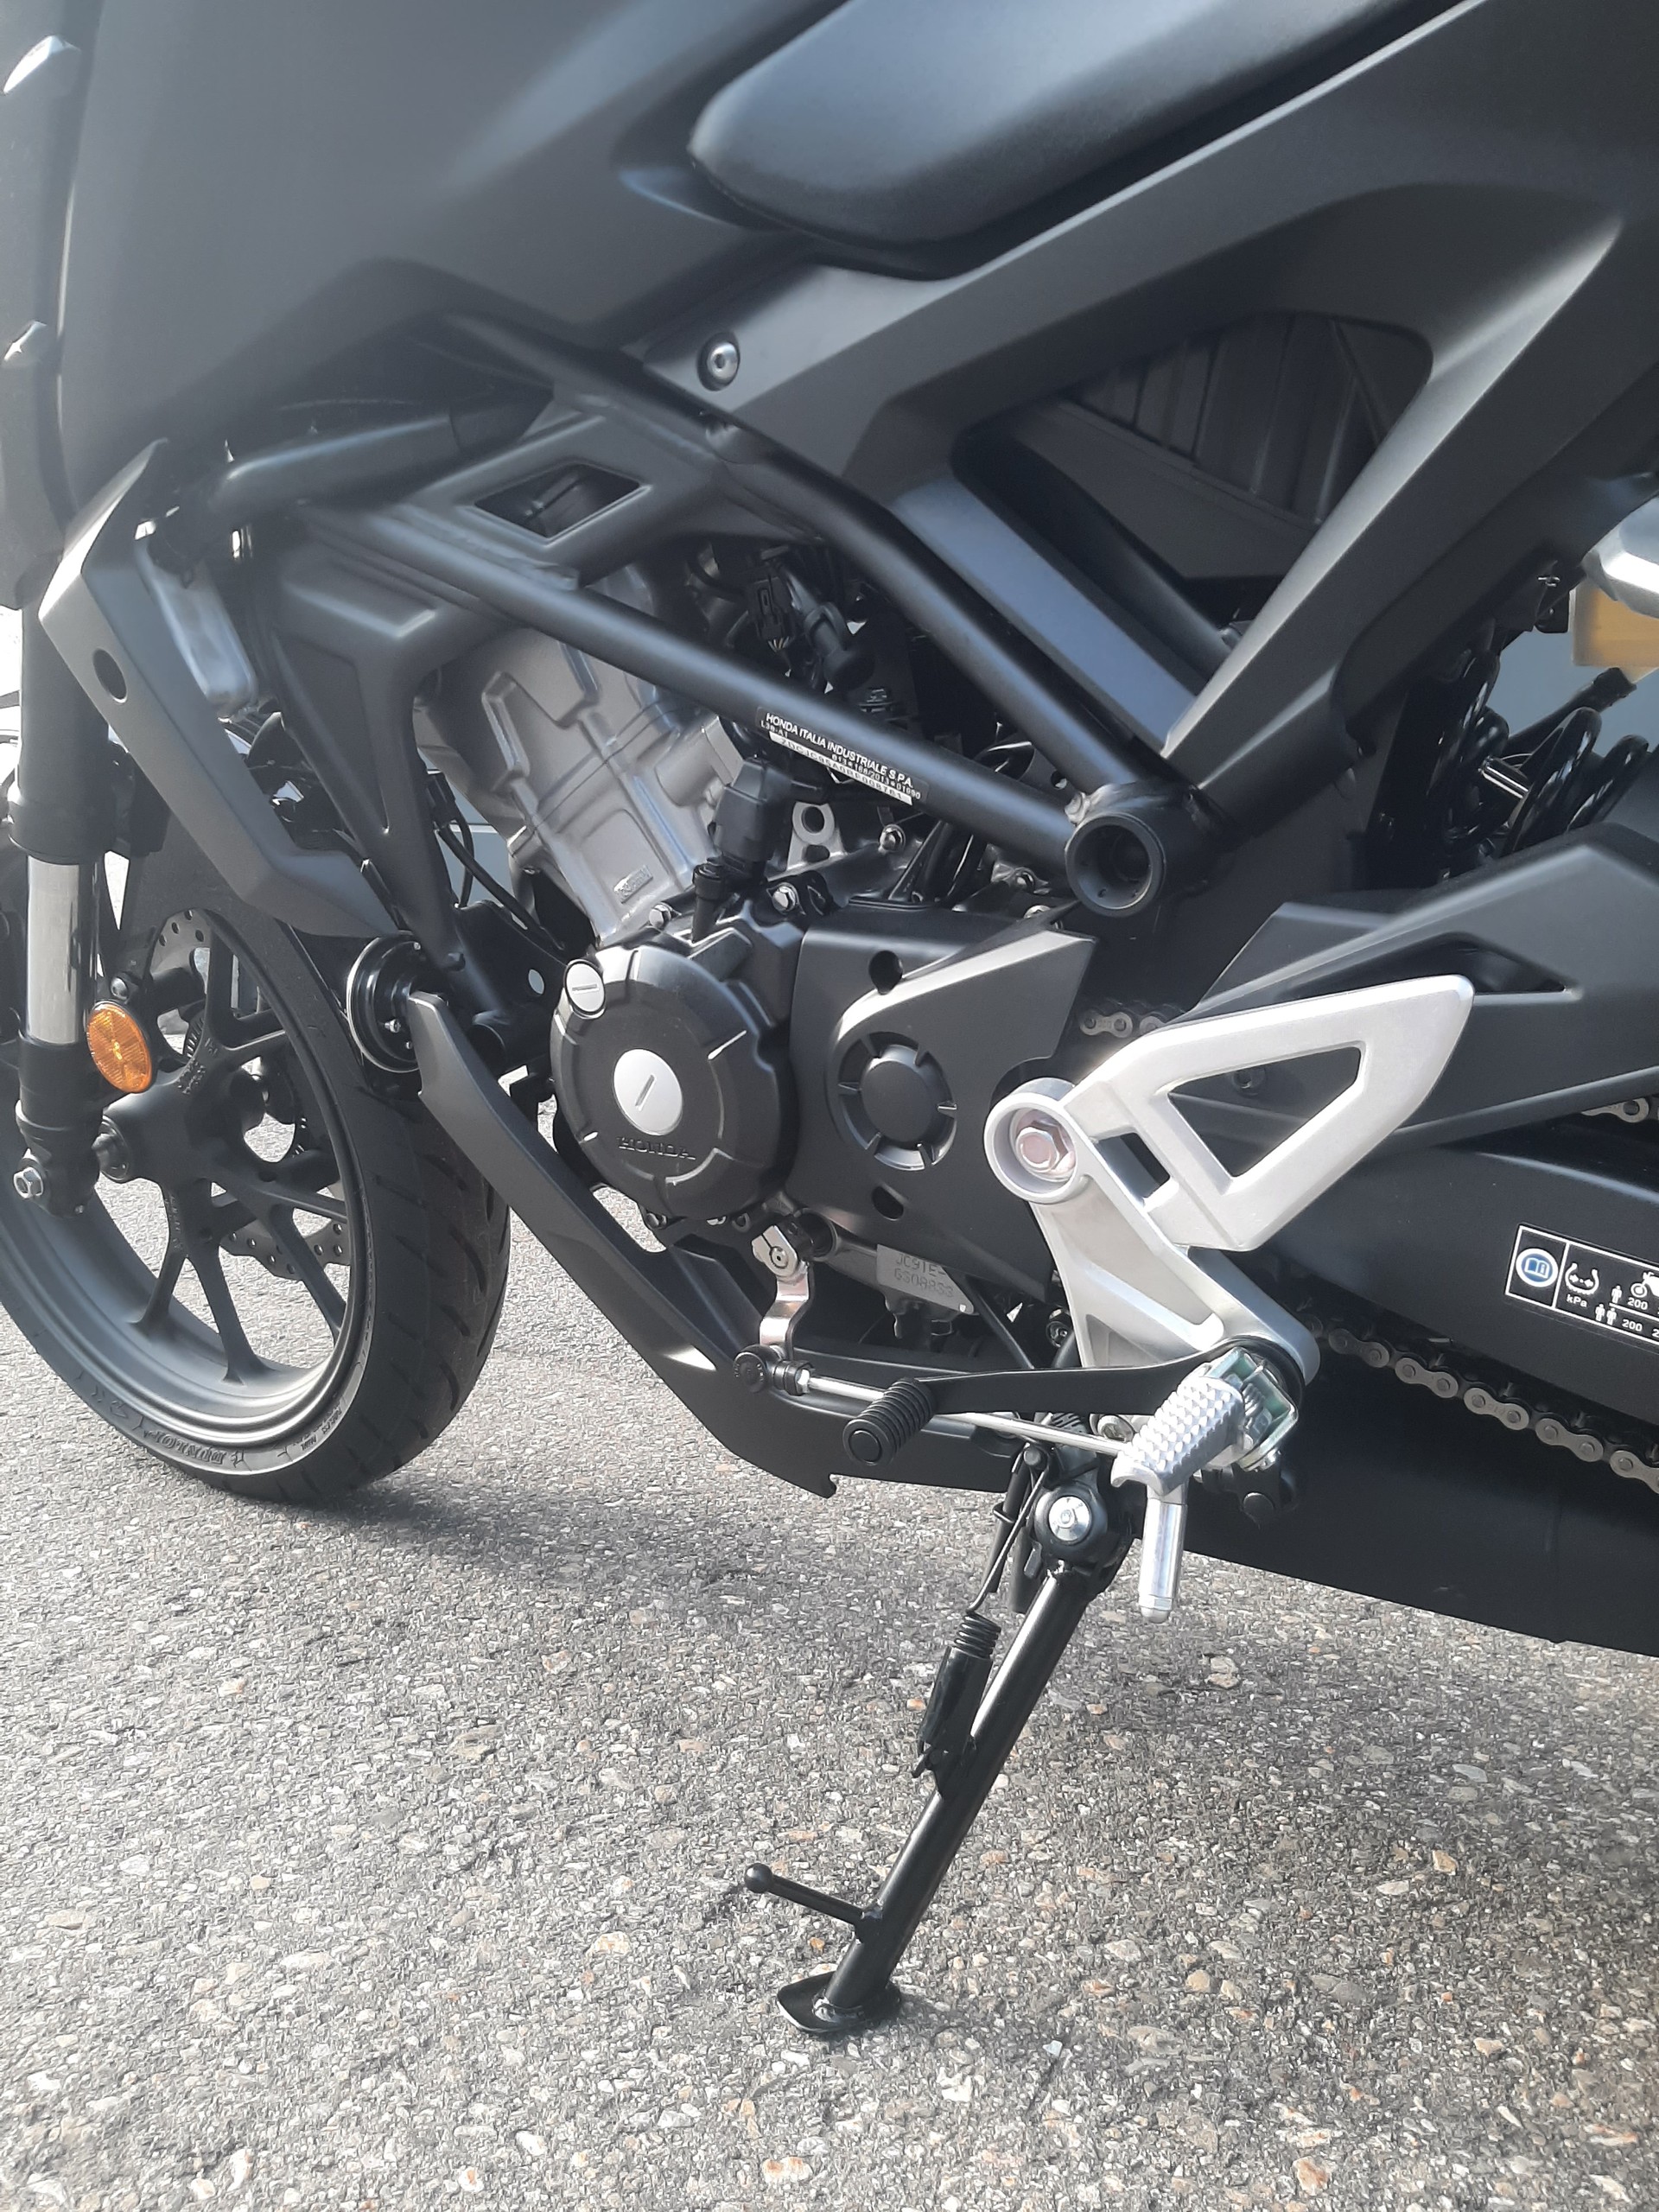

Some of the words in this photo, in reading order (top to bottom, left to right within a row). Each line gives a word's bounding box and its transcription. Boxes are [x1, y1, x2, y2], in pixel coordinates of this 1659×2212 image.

[766, 712, 798, 735] HONDA
[798, 728, 826, 748] ITALIA
[827, 741, 888, 776] INDUSTRIALE
[616, 1136, 696, 1160] HONDA
[1567, 1294, 1588, 1308] kPa
[1627, 1297, 1649, 1311] 200
[1622, 1319, 1643, 1332] 200
